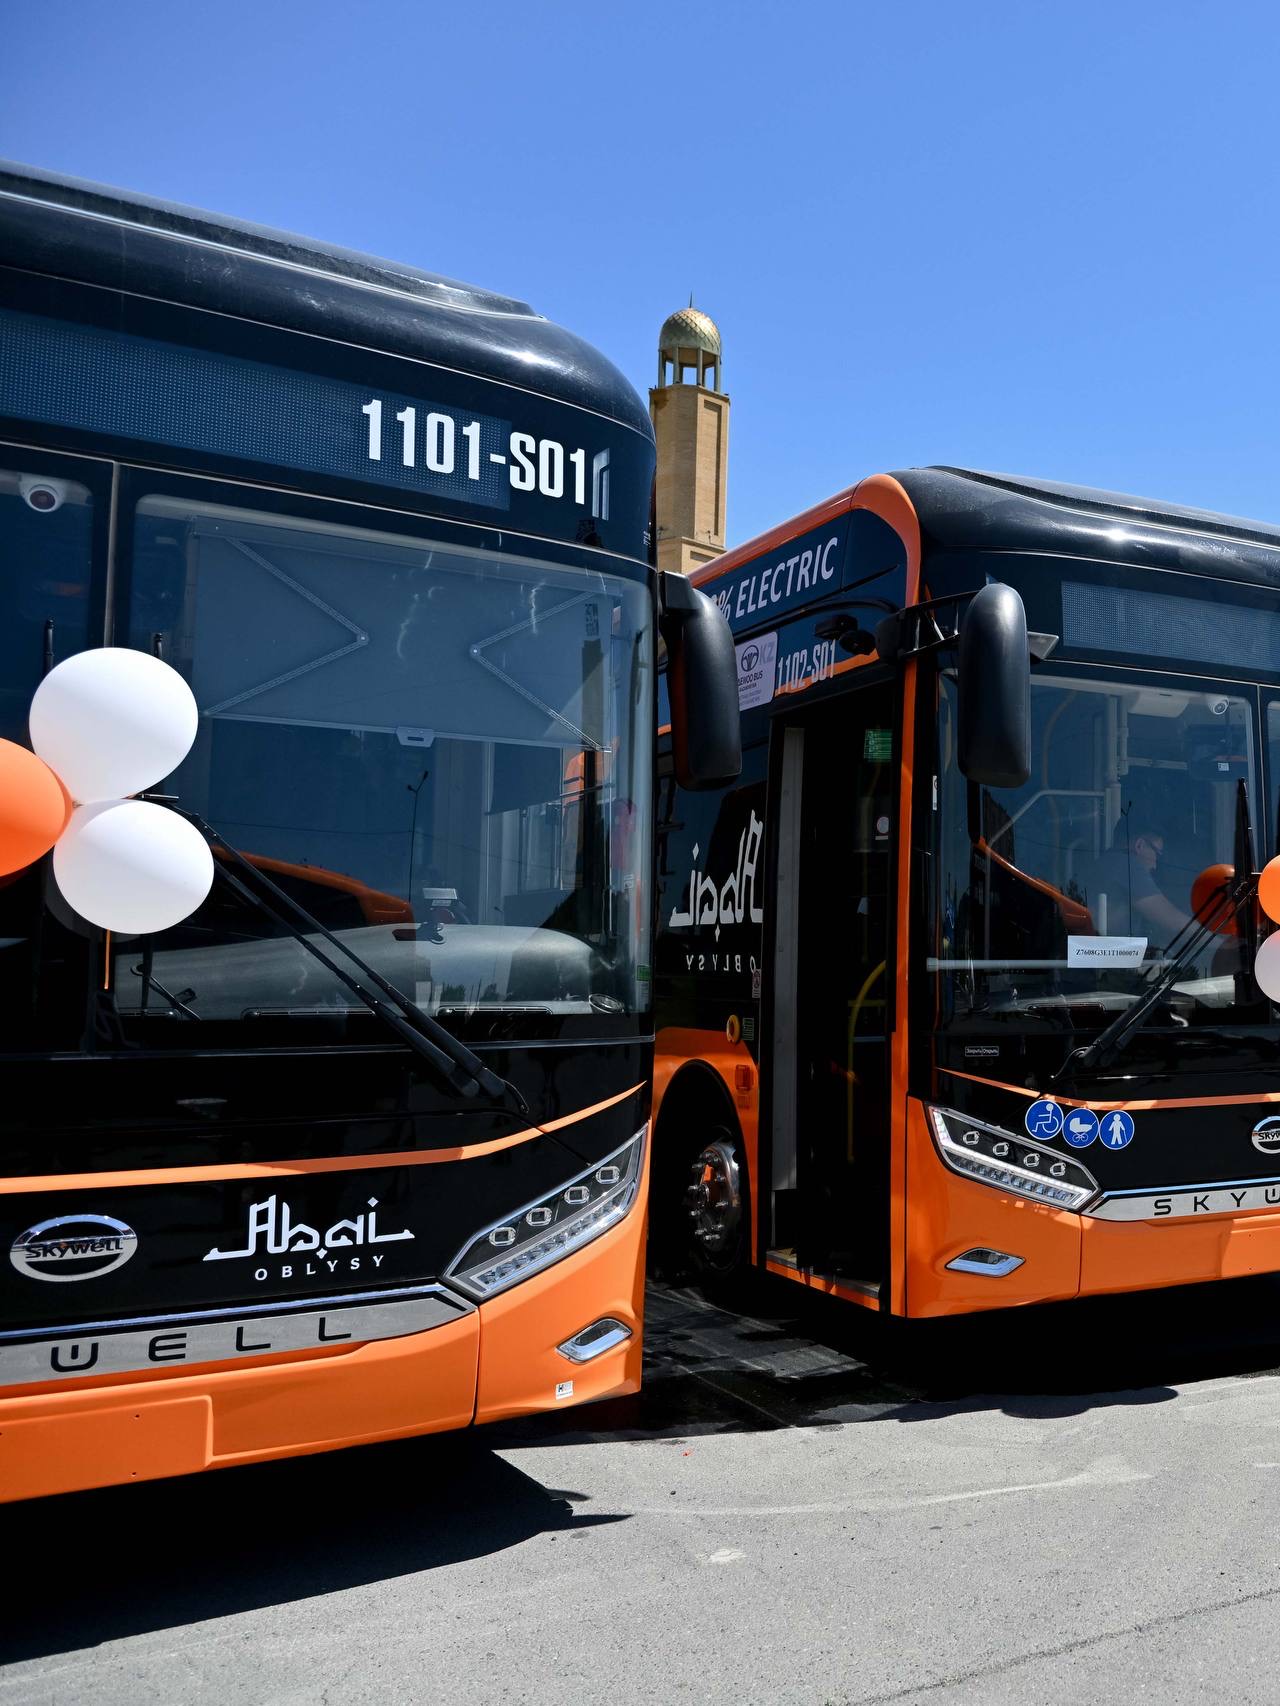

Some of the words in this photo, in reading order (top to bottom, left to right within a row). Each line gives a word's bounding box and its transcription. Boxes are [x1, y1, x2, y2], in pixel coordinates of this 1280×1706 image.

[363, 399, 585, 505] 1101-S01
[736, 537, 838, 618] ELECTRIC
[778, 639, 836, 694] 1102-S01
[203, 1195, 415, 1260] Abai
[254, 1255, 384, 1281] OBLYSY
[51, 1317, 352, 1373] WELL
